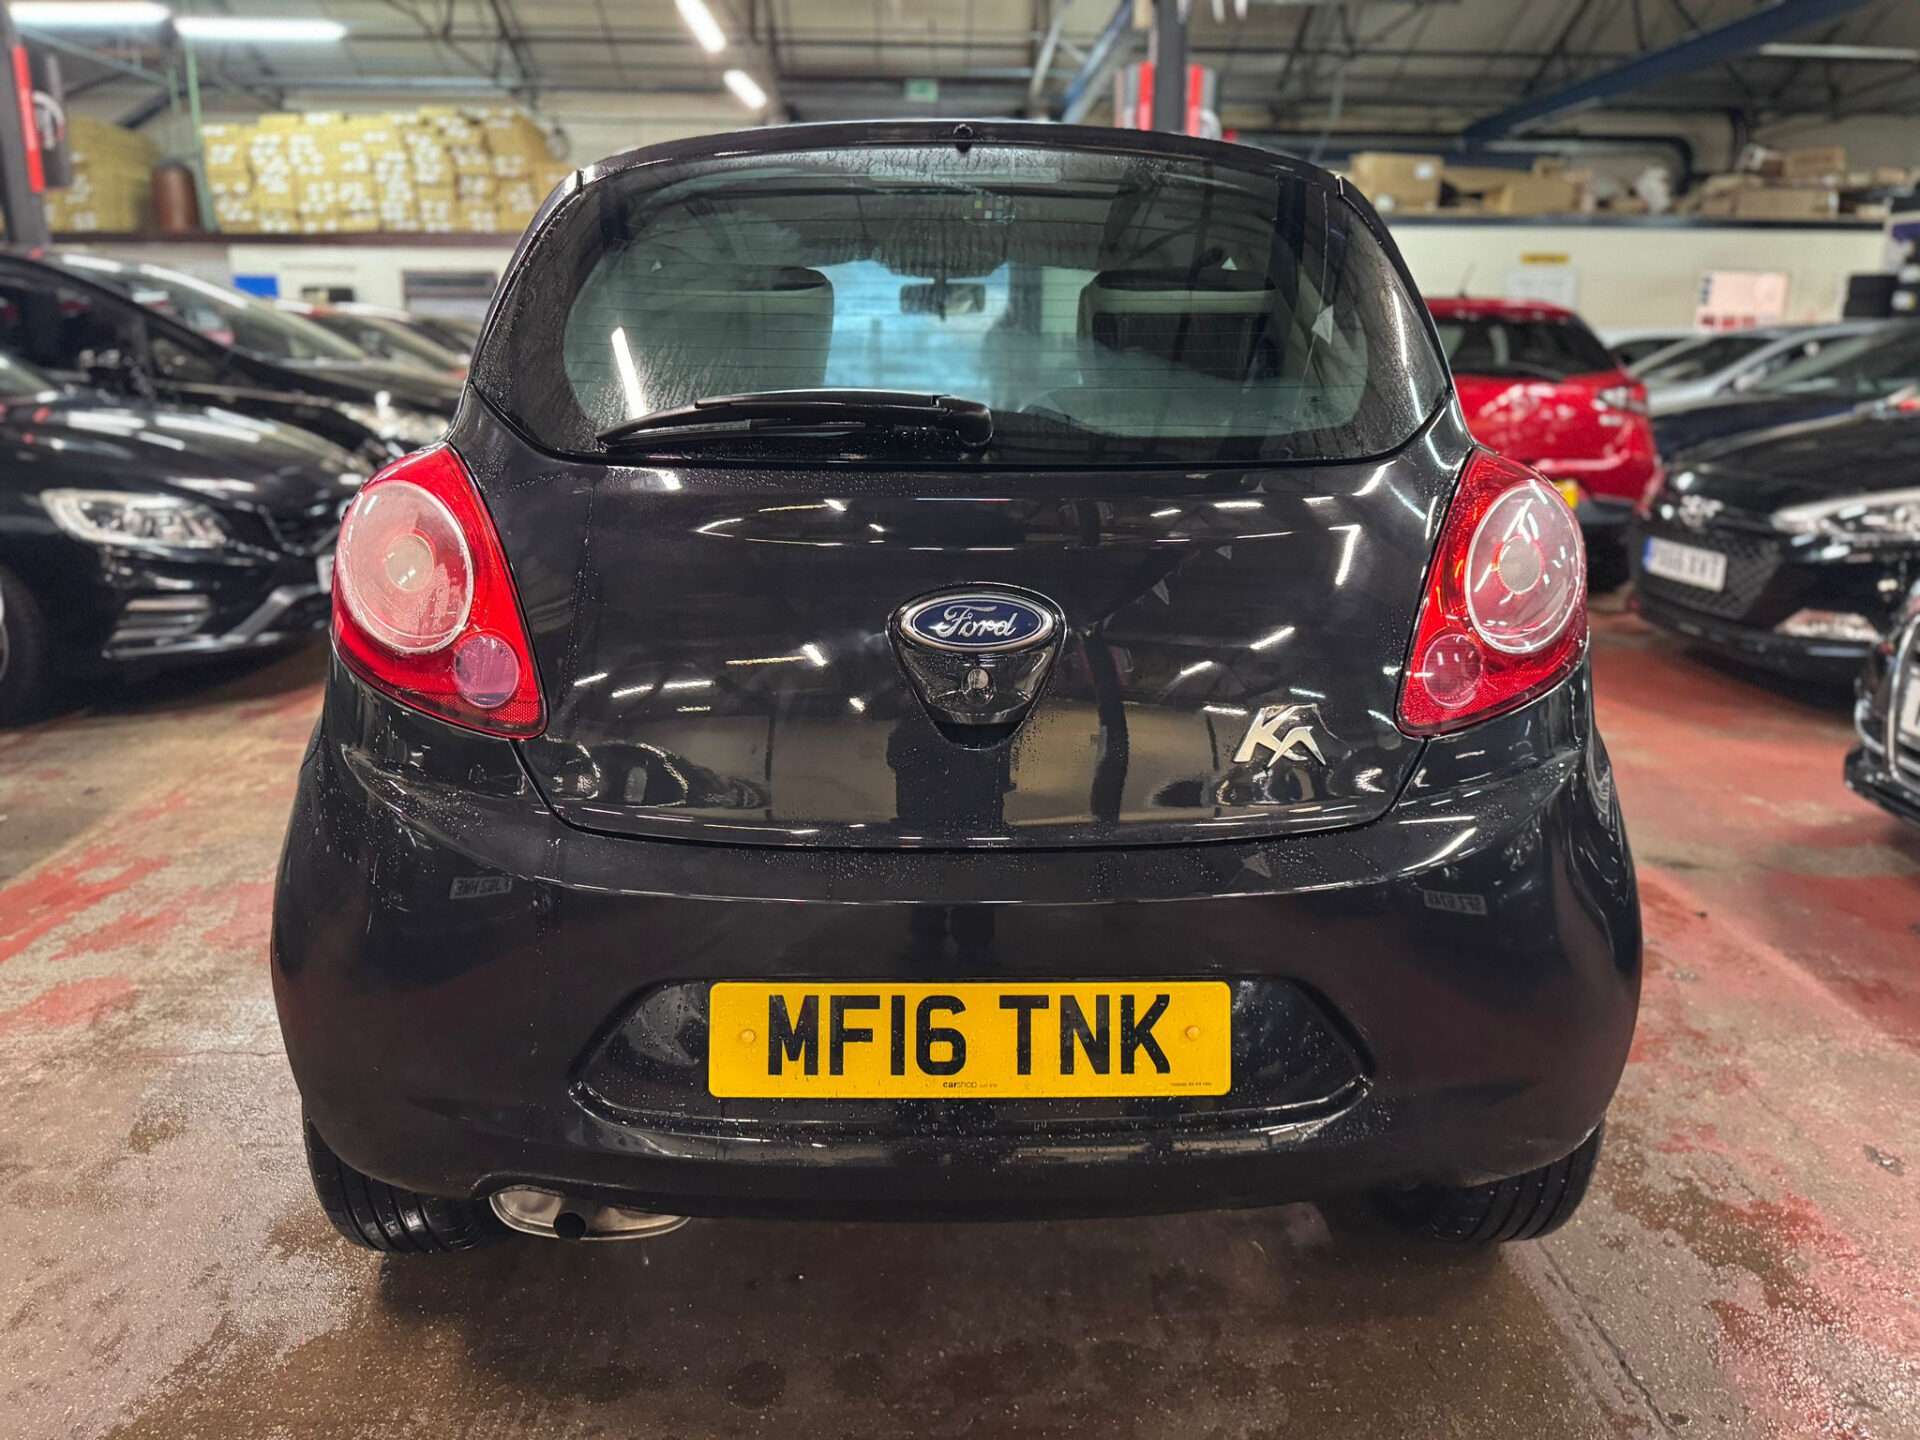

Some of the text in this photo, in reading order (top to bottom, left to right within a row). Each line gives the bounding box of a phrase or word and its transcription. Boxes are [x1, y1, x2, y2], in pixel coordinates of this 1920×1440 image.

[928, 605, 1018, 637] Ford
[768, 994, 1171, 1075] MF16 TNK
